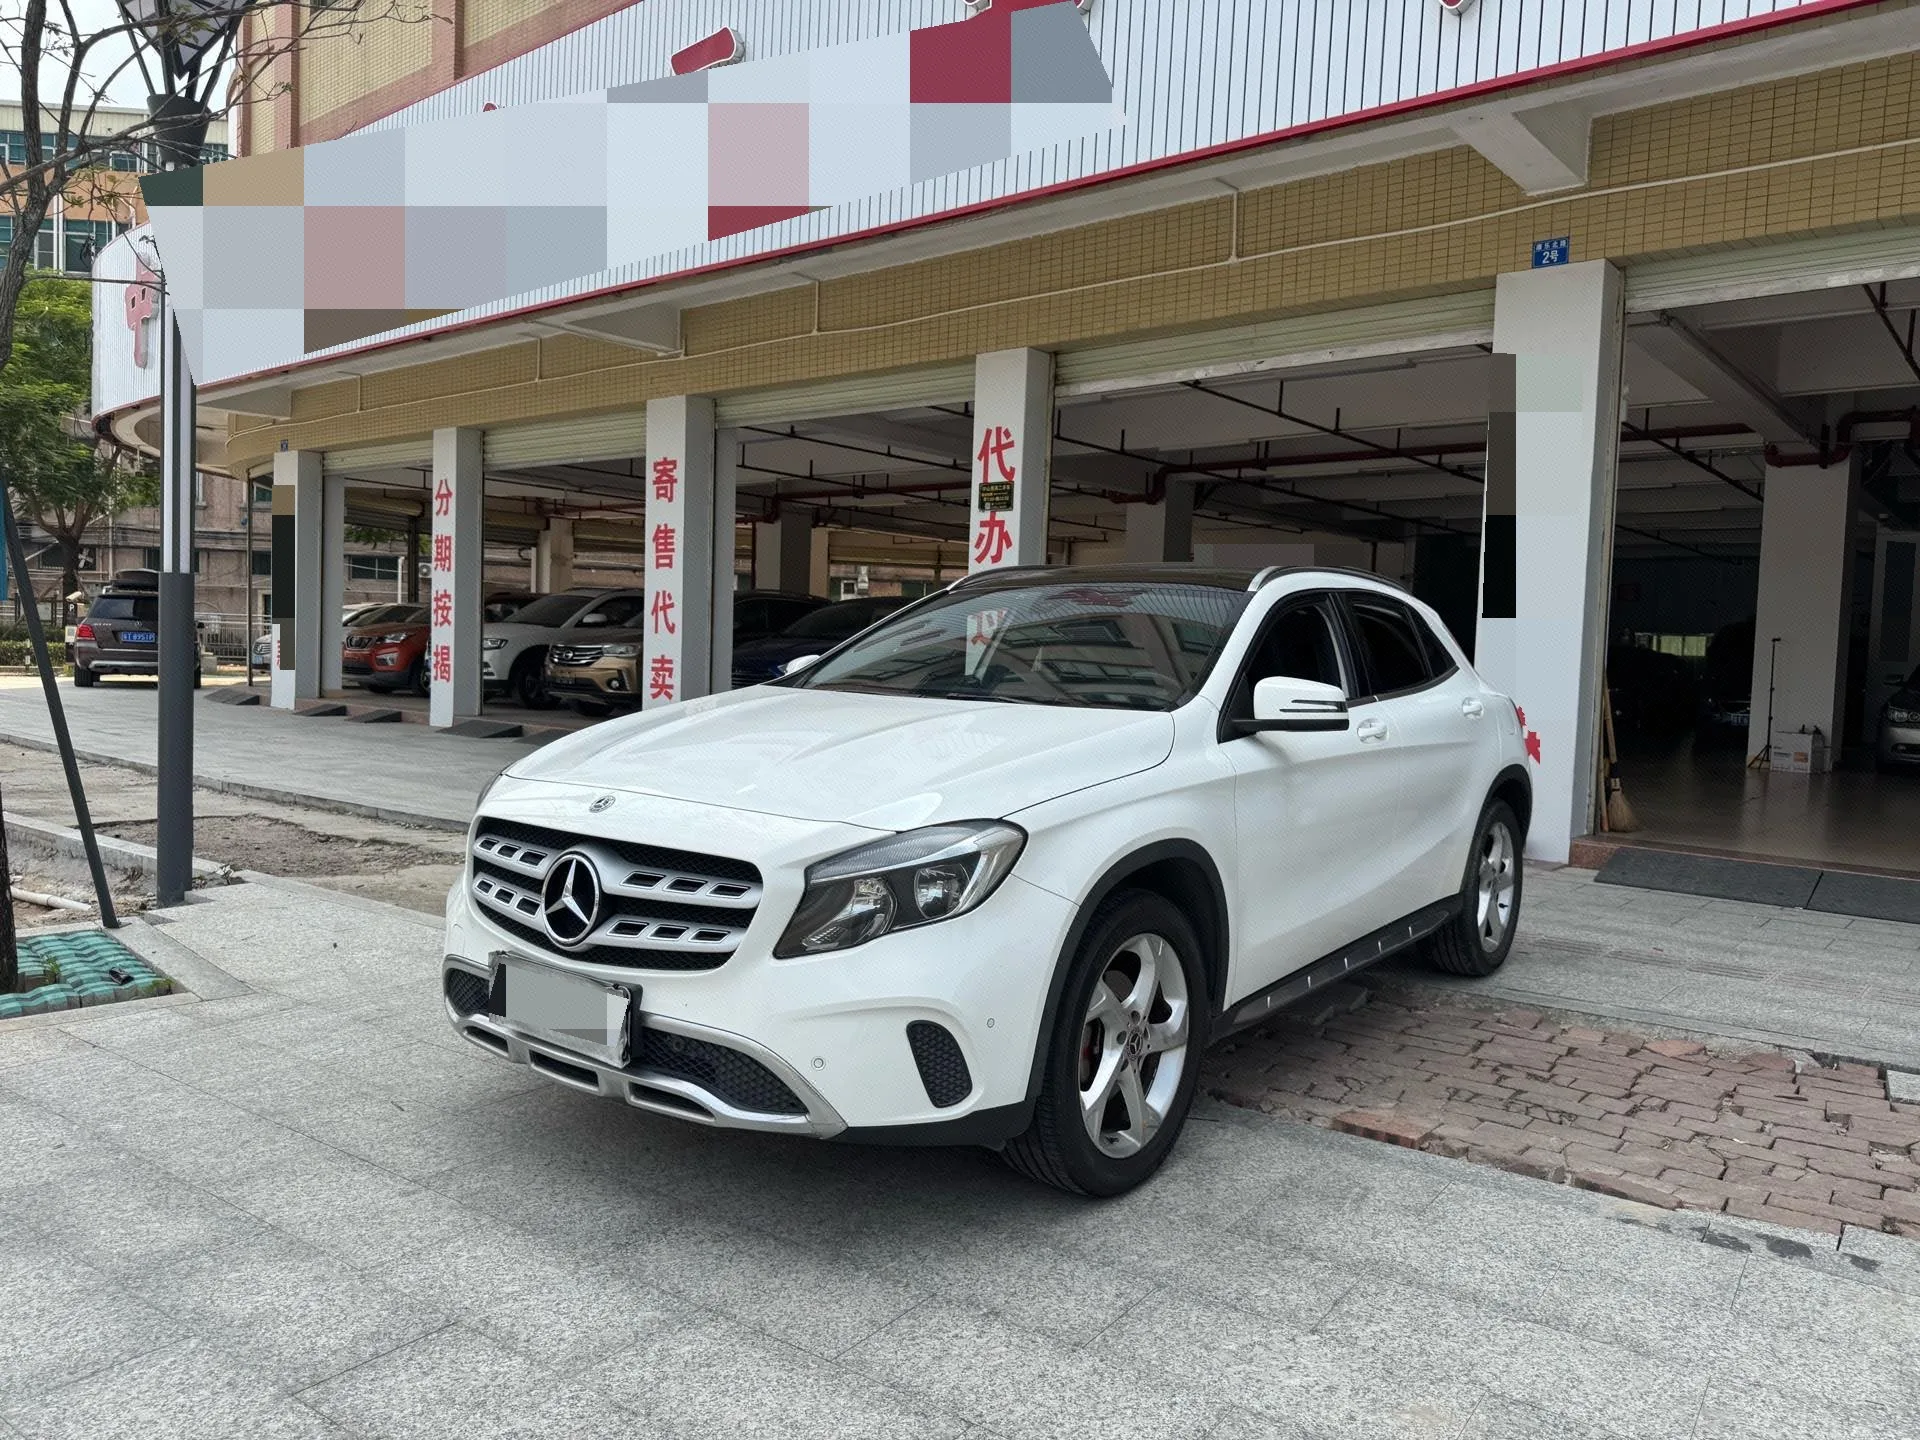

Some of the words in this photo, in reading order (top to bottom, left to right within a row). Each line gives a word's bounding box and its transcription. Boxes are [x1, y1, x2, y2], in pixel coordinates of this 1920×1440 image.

[1542, 250, 1560, 264] 2号
[433, 479, 453, 682] 分期按揭
[650, 457, 678, 700] 寄售代卖
